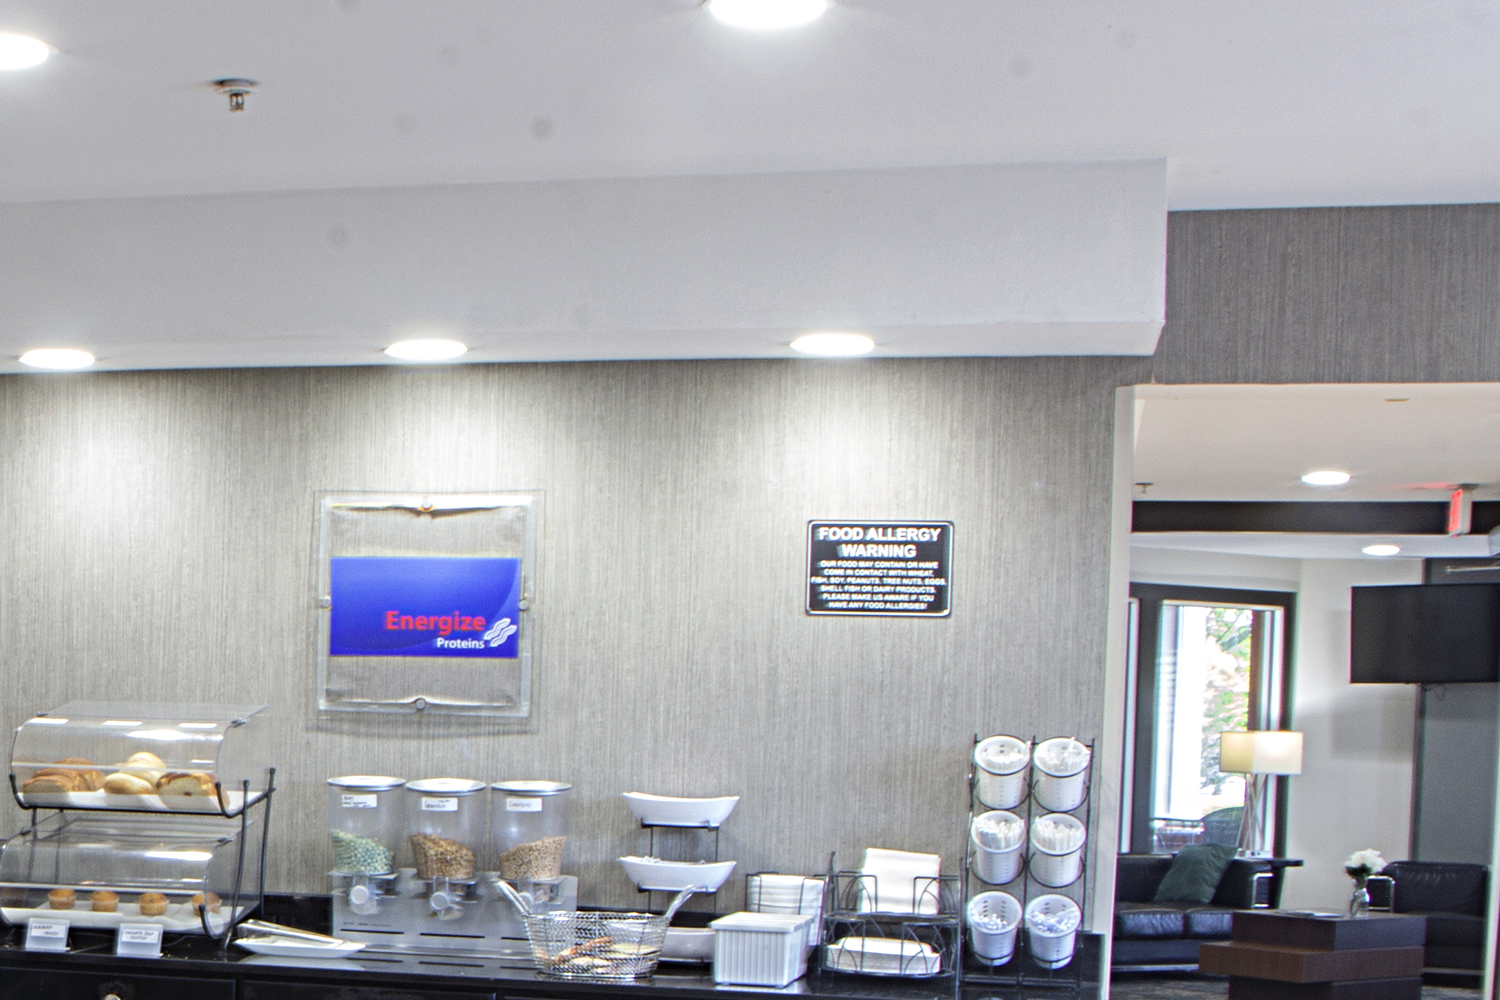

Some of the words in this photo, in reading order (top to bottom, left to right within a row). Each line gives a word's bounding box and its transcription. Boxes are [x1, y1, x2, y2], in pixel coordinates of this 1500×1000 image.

[819, 527, 864, 540] FOOD
[866, 528, 942, 542] ALLERGY
[841, 544, 917, 558] WARNING
[820, 560, 836, 568] OUR
[838, 560, 858, 568] FOOD
[919, 594, 934, 602] YOU
[885, 602, 928, 610] ALLERGIES!
[386, 611, 485, 636] Energize
[437, 637, 485, 649] Proteins
